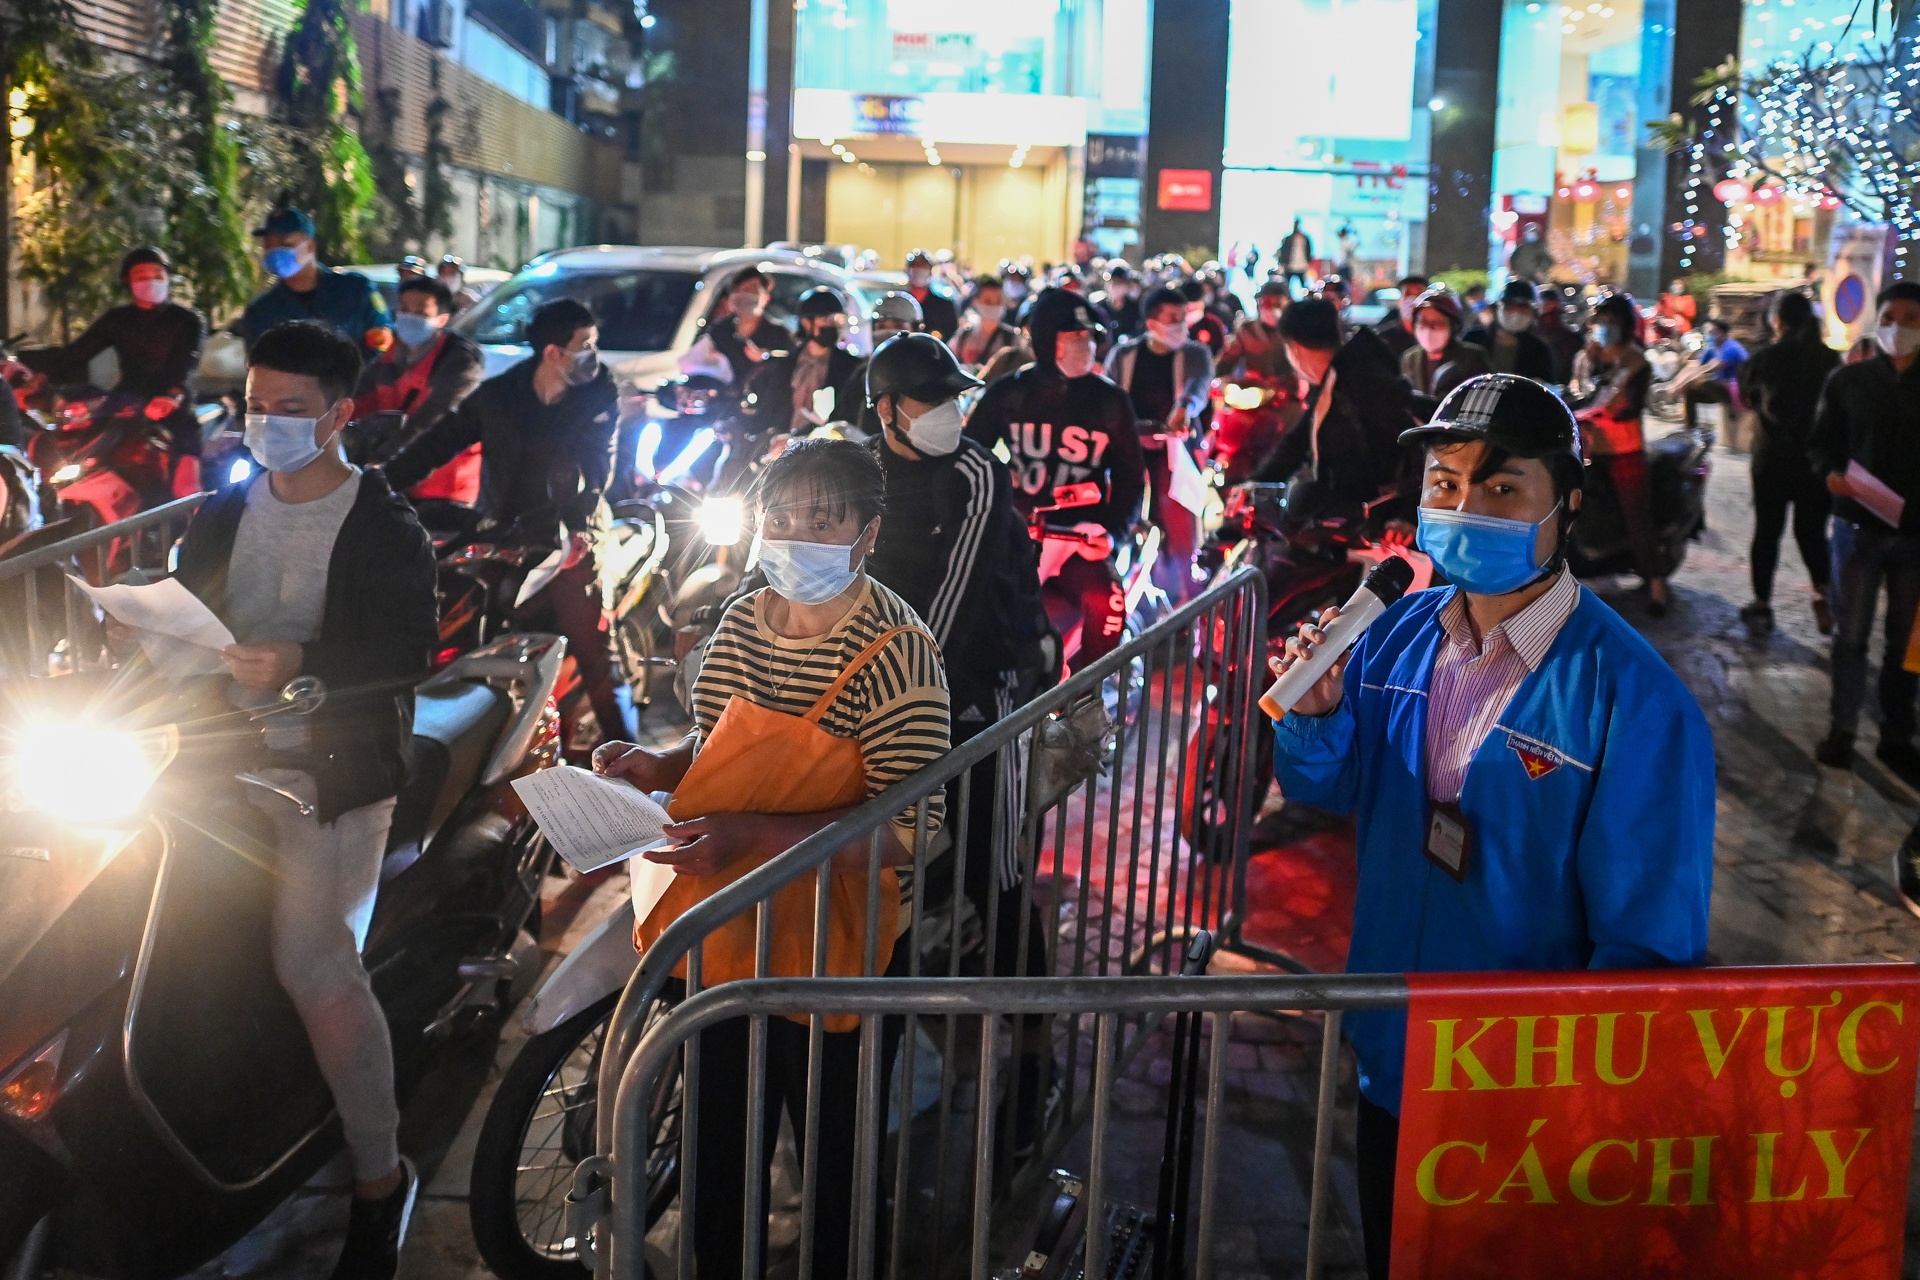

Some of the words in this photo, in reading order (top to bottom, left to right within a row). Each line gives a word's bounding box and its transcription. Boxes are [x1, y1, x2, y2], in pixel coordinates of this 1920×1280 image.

[1511, 739, 1529, 750] THANH
[1422, 1010, 1660, 1092] KHU
[1686, 990, 1905, 1099] VỰC
[1415, 1118, 1721, 1207] CÁCH
[1744, 1127, 1875, 1204] LY
